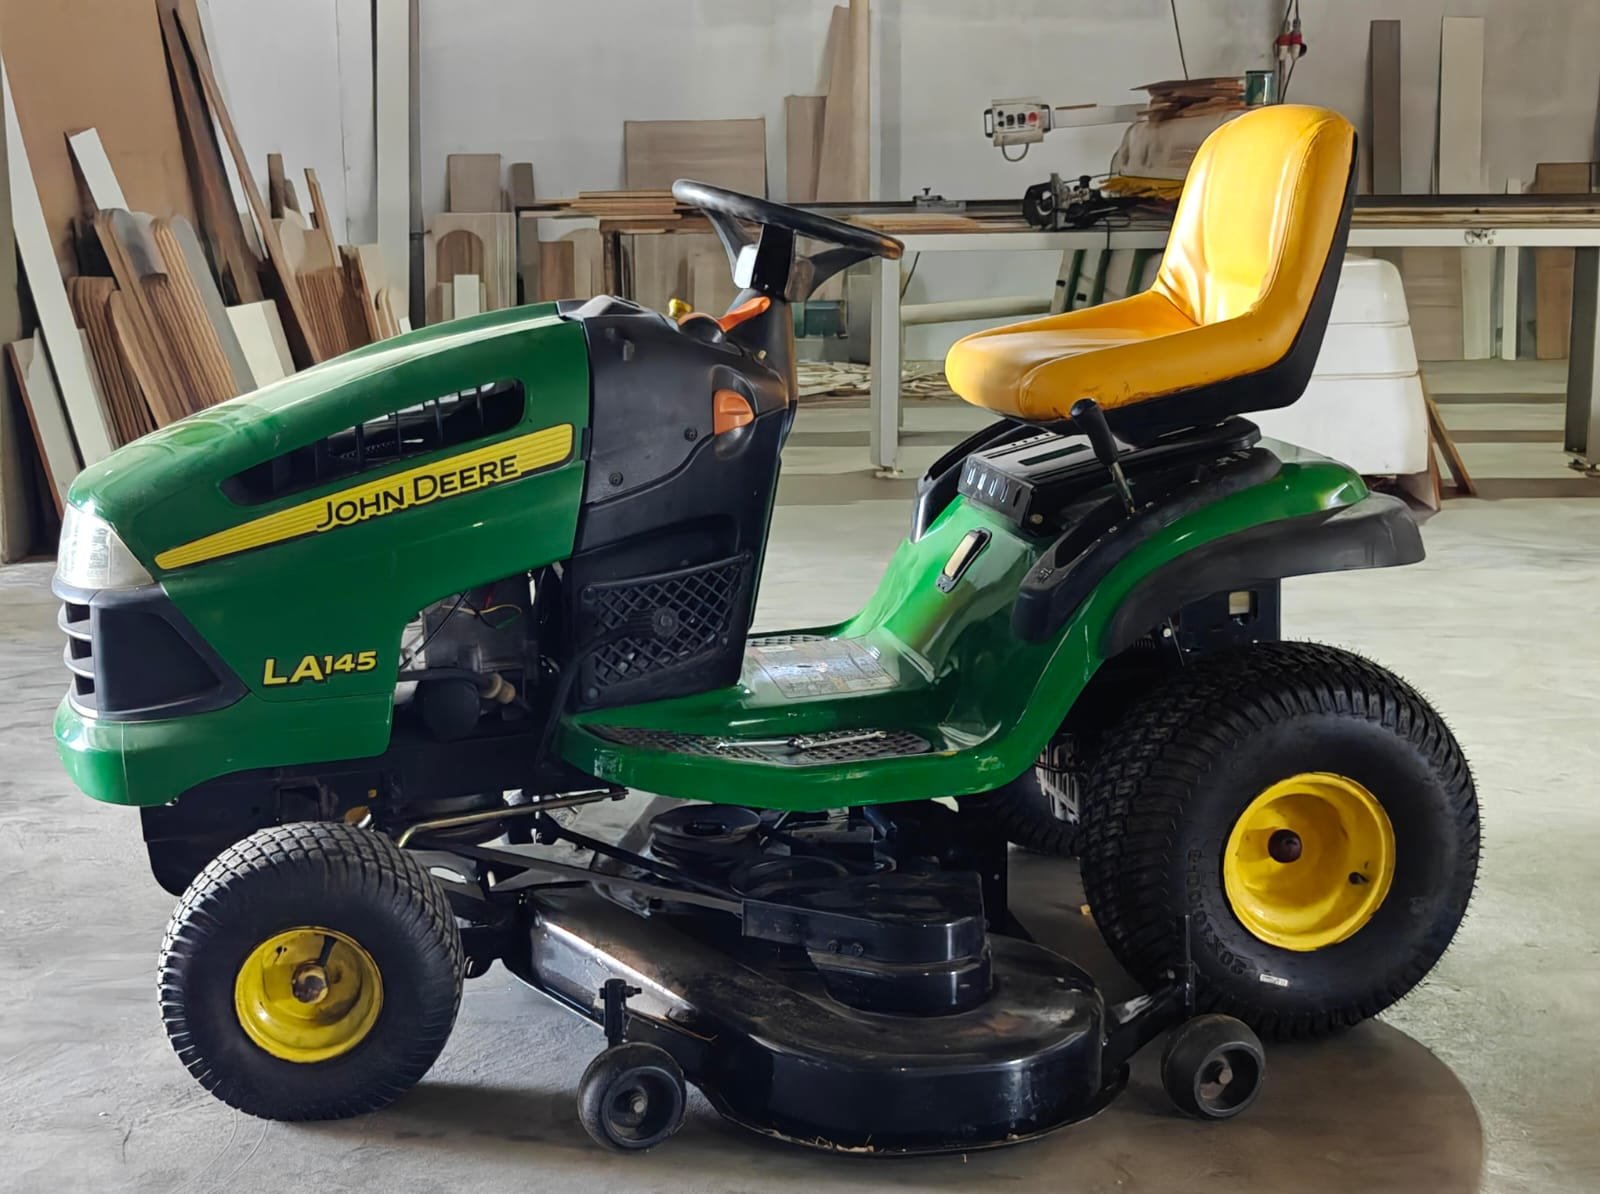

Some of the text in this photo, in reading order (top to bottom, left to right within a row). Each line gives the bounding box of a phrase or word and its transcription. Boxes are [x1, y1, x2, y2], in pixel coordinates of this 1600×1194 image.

[317, 455, 519, 529] JOHN DEERE
[263, 650, 378, 686] LA145
